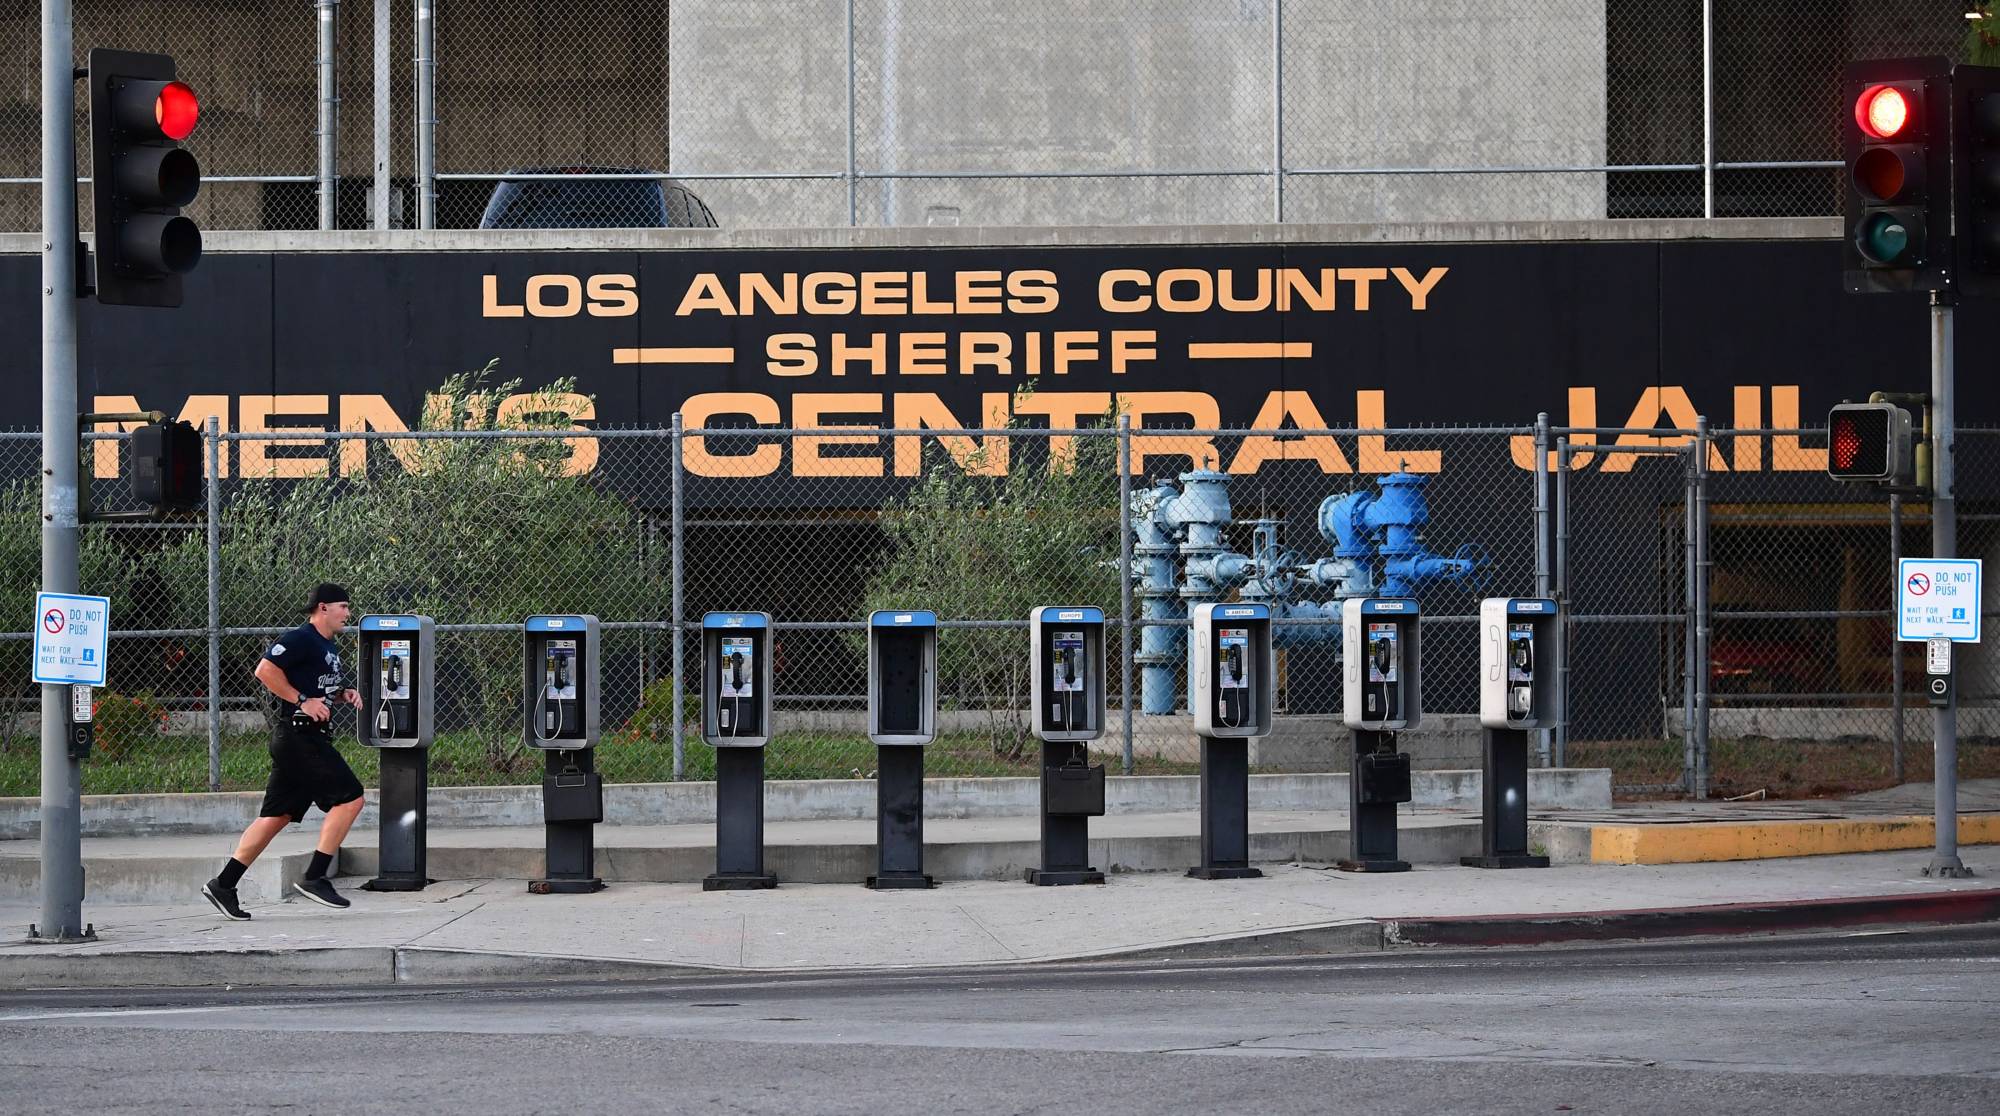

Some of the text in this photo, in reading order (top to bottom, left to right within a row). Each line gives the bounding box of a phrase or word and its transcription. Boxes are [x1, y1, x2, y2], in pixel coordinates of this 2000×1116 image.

[483, 267, 1449, 317] LOS ANGELES COUNTY
[766, 330, 1157, 376] SHERIFF
[682, 391, 1442, 478] CENTRAL
[1511, 385, 1830, 473] JAIL
[1935, 572, 1972, 583] DO NOT
[1935, 585, 1957, 596] PUSH
[70, 609, 102, 622] DO NOT
[1927, 616, 1944, 624] WALK
[68, 623, 88, 636] PUSH
[42, 645, 71, 655] WAIT FOR
[41, 656, 75, 665] NEXT WALK
